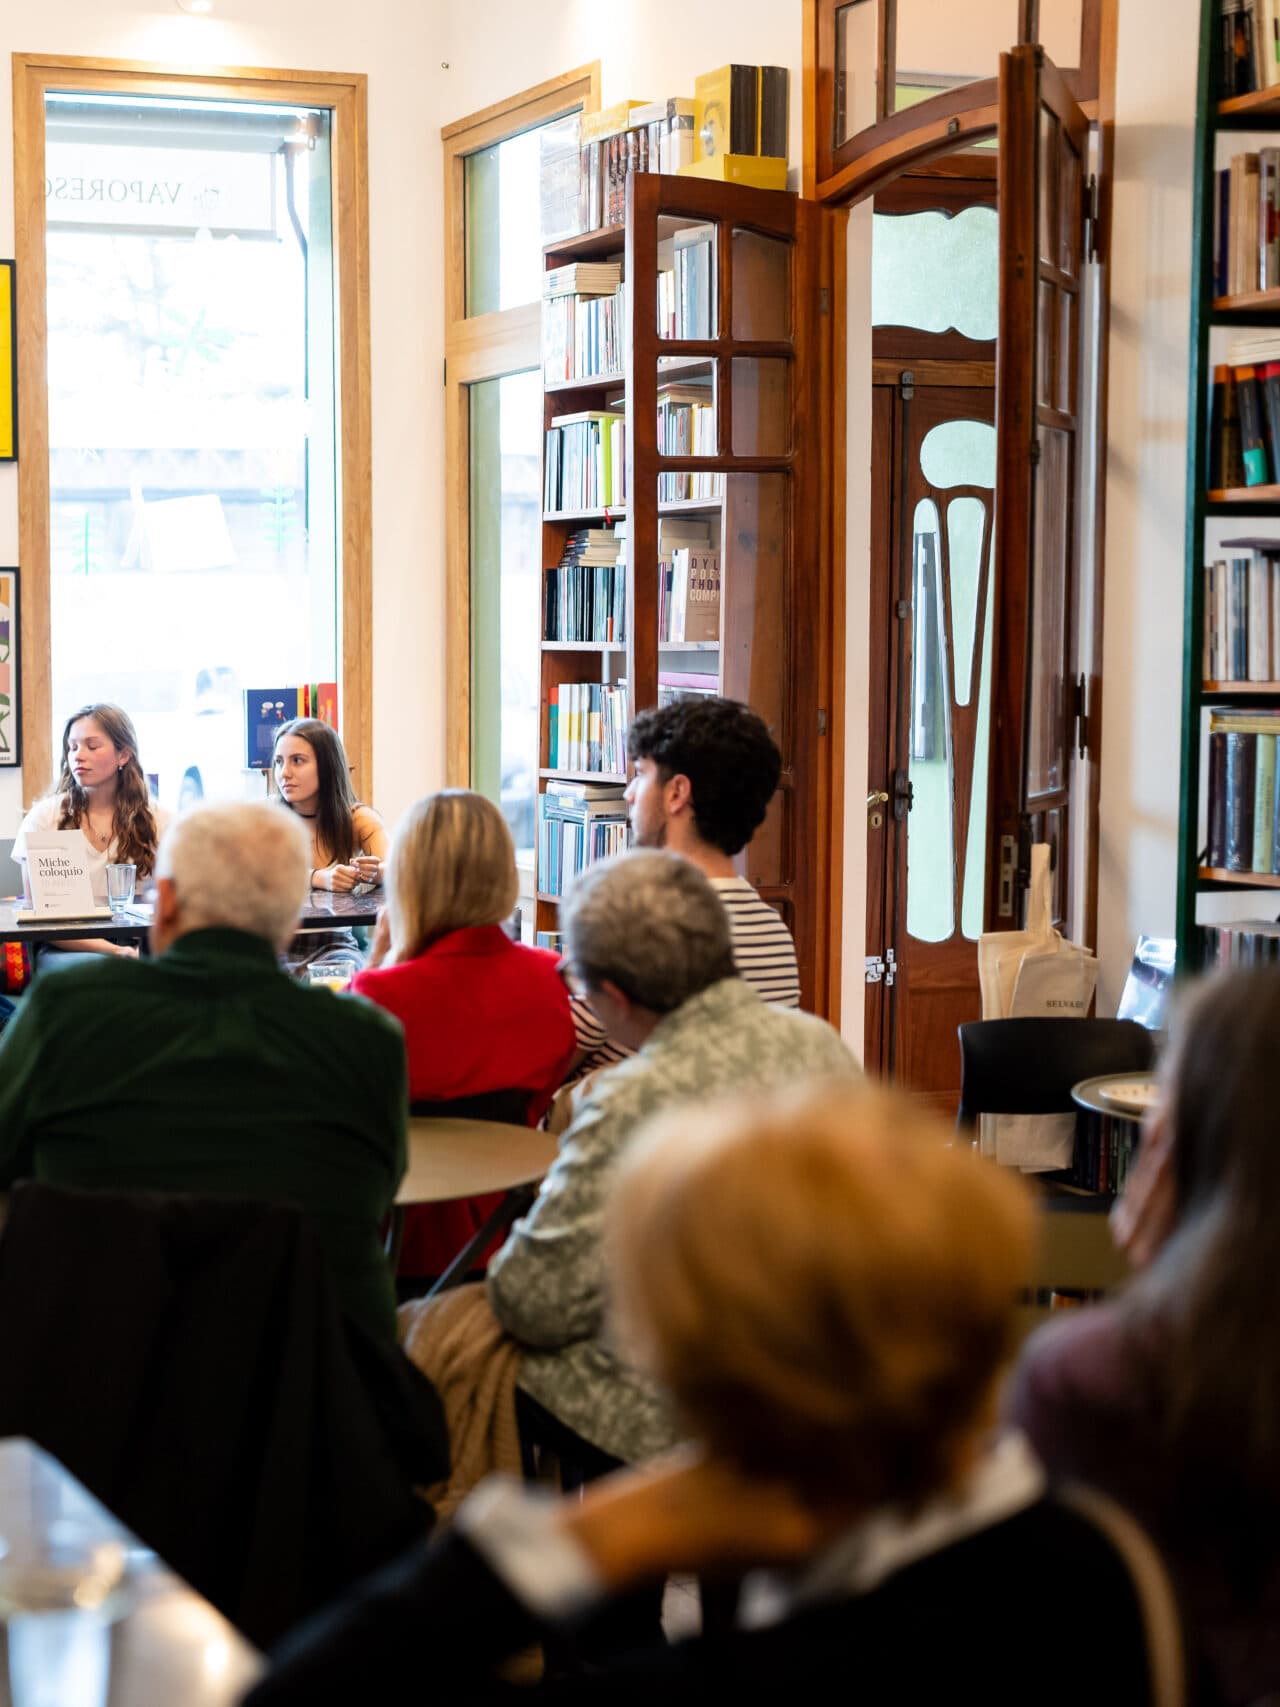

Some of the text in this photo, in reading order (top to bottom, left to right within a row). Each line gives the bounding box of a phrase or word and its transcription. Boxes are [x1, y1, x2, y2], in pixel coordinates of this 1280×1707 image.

[691, 557, 719, 570] DYL
[690, 568, 720, 580] POE
[39, 857, 71, 868] Miche
[39, 866, 84, 879] coloquio
